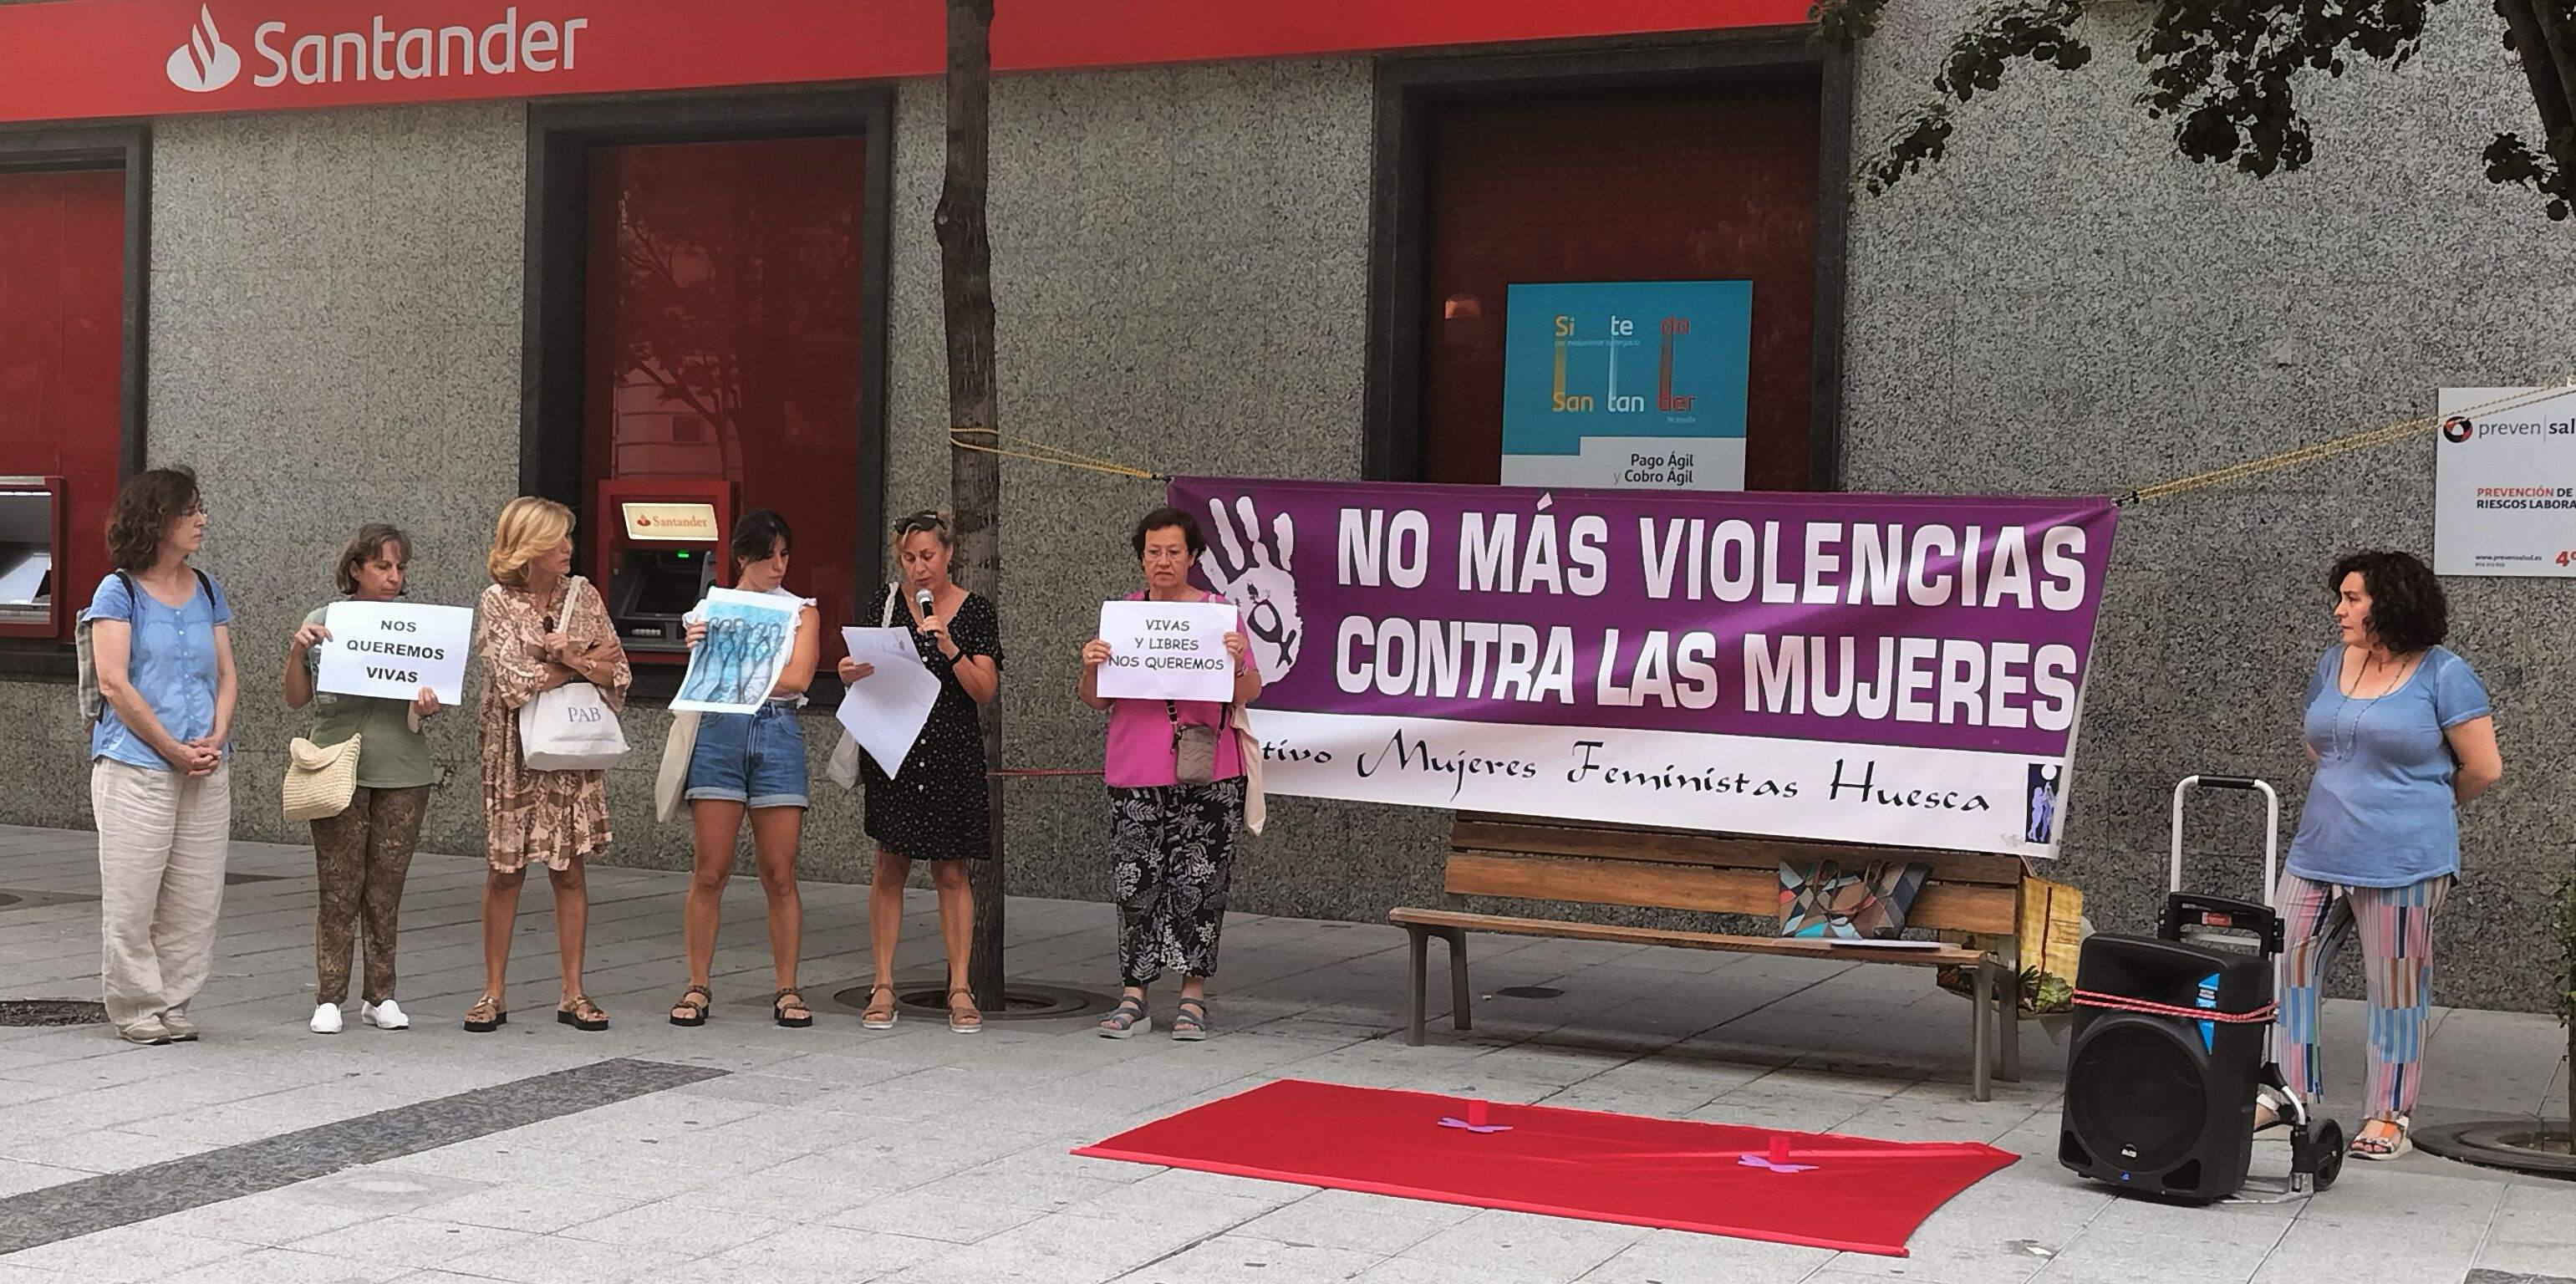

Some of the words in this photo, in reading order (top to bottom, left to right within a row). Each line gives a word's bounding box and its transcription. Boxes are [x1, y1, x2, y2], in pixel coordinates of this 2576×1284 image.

[254, 6, 588, 87] Santander
[1555, 314, 1576, 336] Si
[1611, 315, 1633, 335] te
[1552, 391, 1594, 412] San
[1607, 393, 1645, 412] tan
[1659, 394, 1696, 411] der
[2479, 423, 2541, 439] preven
[1631, 453, 1664, 469] Pago
[1667, 451, 1694, 470] Ágil
[1613, 472, 1621, 485] y
[1624, 469, 1663, 482] Cobro
[1667, 467, 1693, 486] Ágil
[2477, 485, 2554, 497] PREVENCIÓN
[2557, 487, 2573, 497] DE
[2477, 499, 2528, 509] RIESGOS
[2529, 499, 2576, 509] LABORA
[652, 516, 707, 527] Santander
[1337, 507, 1429, 588] NO
[1459, 492, 1607, 596] MÁS
[1639, 517, 2086, 611] VIOLENCIAS
[380, 619, 417, 633] NOS
[1145, 619, 1190, 632] VIVAS
[346, 639, 445, 660] QUEREMOS
[1134, 637, 1144, 649] Y
[1148, 638, 1199, 650] LIBRES
[1108, 655, 1140, 667] NOS
[1145, 656, 1224, 670] QUEREMOS
[366, 666, 419, 683] VIVAS
[1336, 614, 1575, 705] CONTRA
[1596, 628, 1718, 709] LAS
[1744, 633, 2078, 732] MUJERES
[568, 706, 601, 722] PAB
[1356, 727, 1537, 802] Mujeres
[1567, 741, 1799, 798] Feministas
[1829, 758, 1990, 812] Huesca
